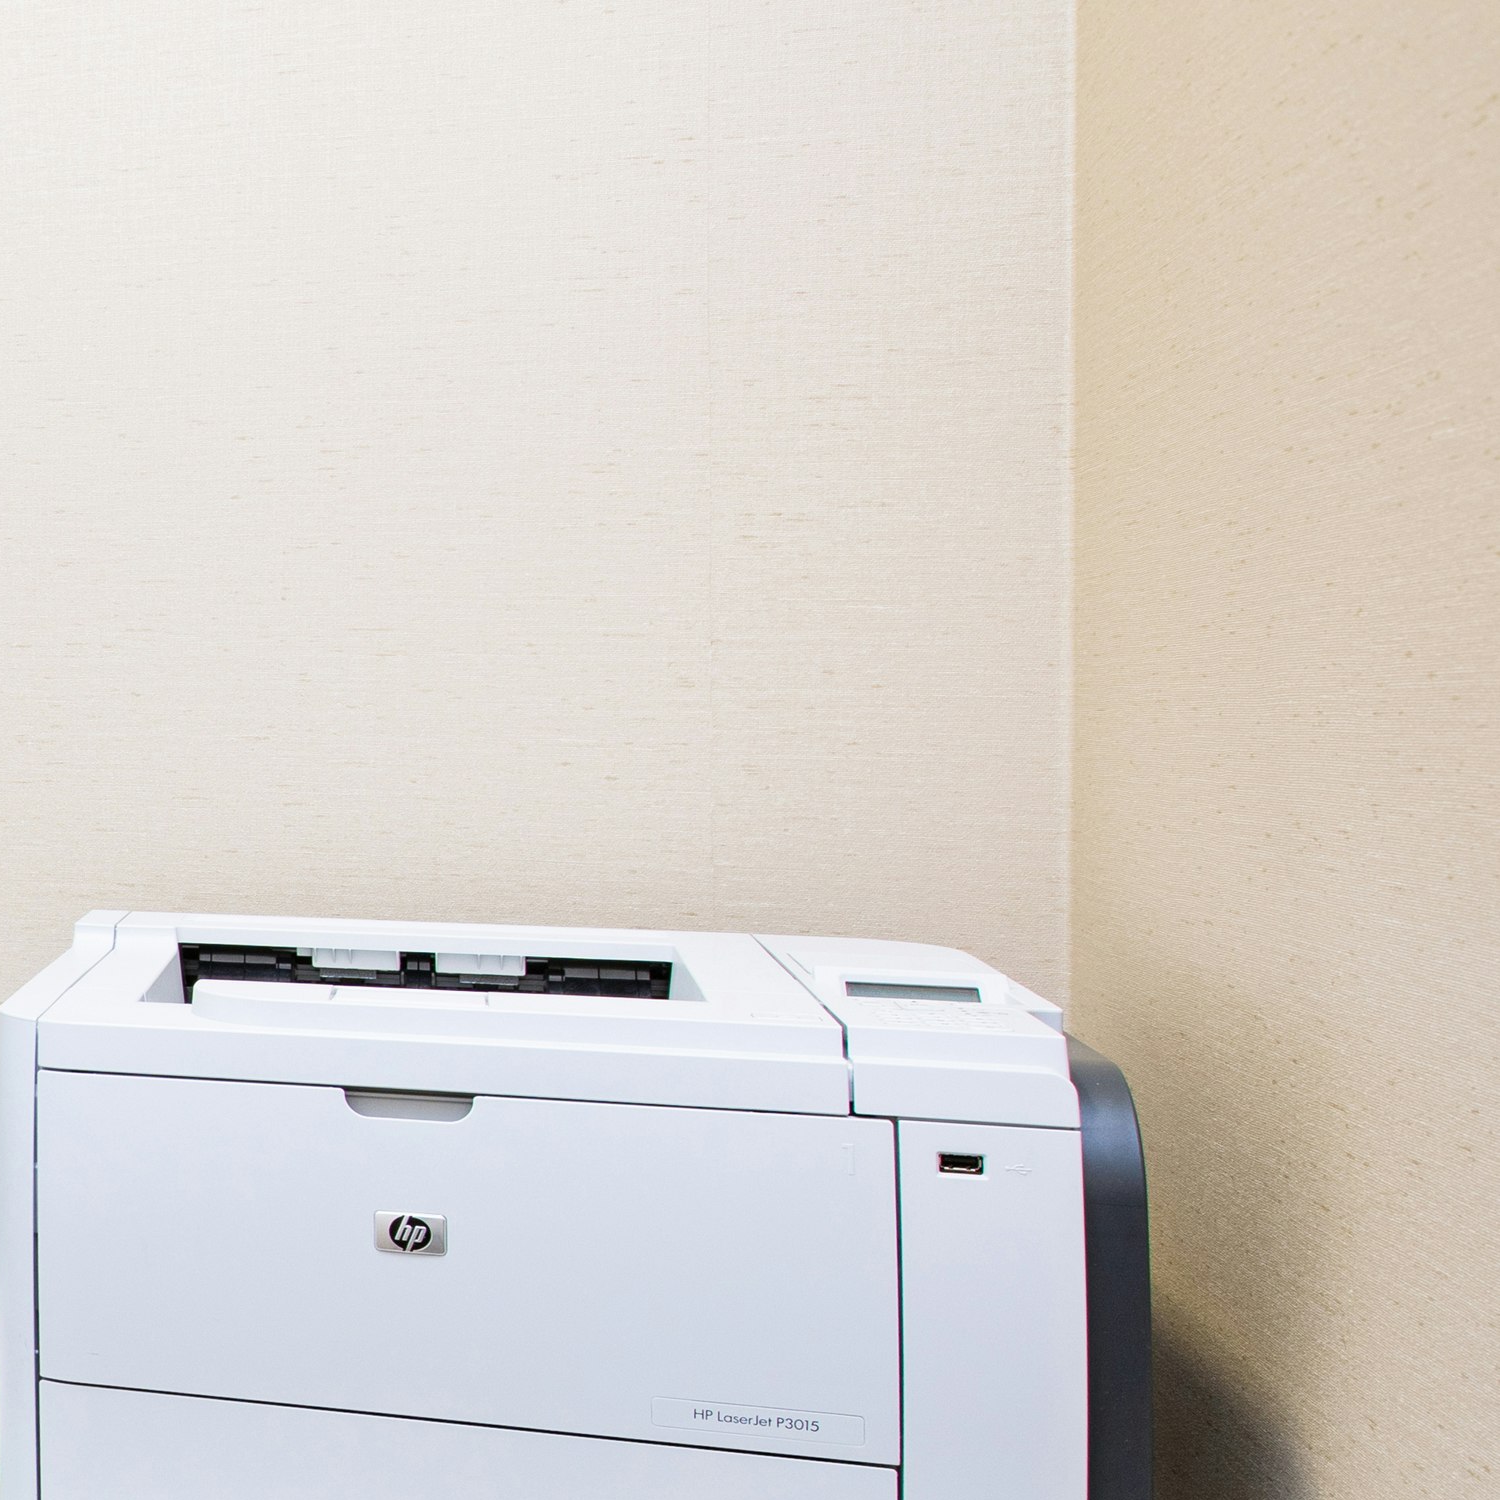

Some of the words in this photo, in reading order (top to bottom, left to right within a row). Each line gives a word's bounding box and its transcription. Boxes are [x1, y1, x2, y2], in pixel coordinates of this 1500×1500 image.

[394, 1214, 427, 1252] hp
[693, 1408, 713, 1421] HP
[717, 1410, 772, 1428] LaserJet
[776, 1417, 820, 1433] P3015
